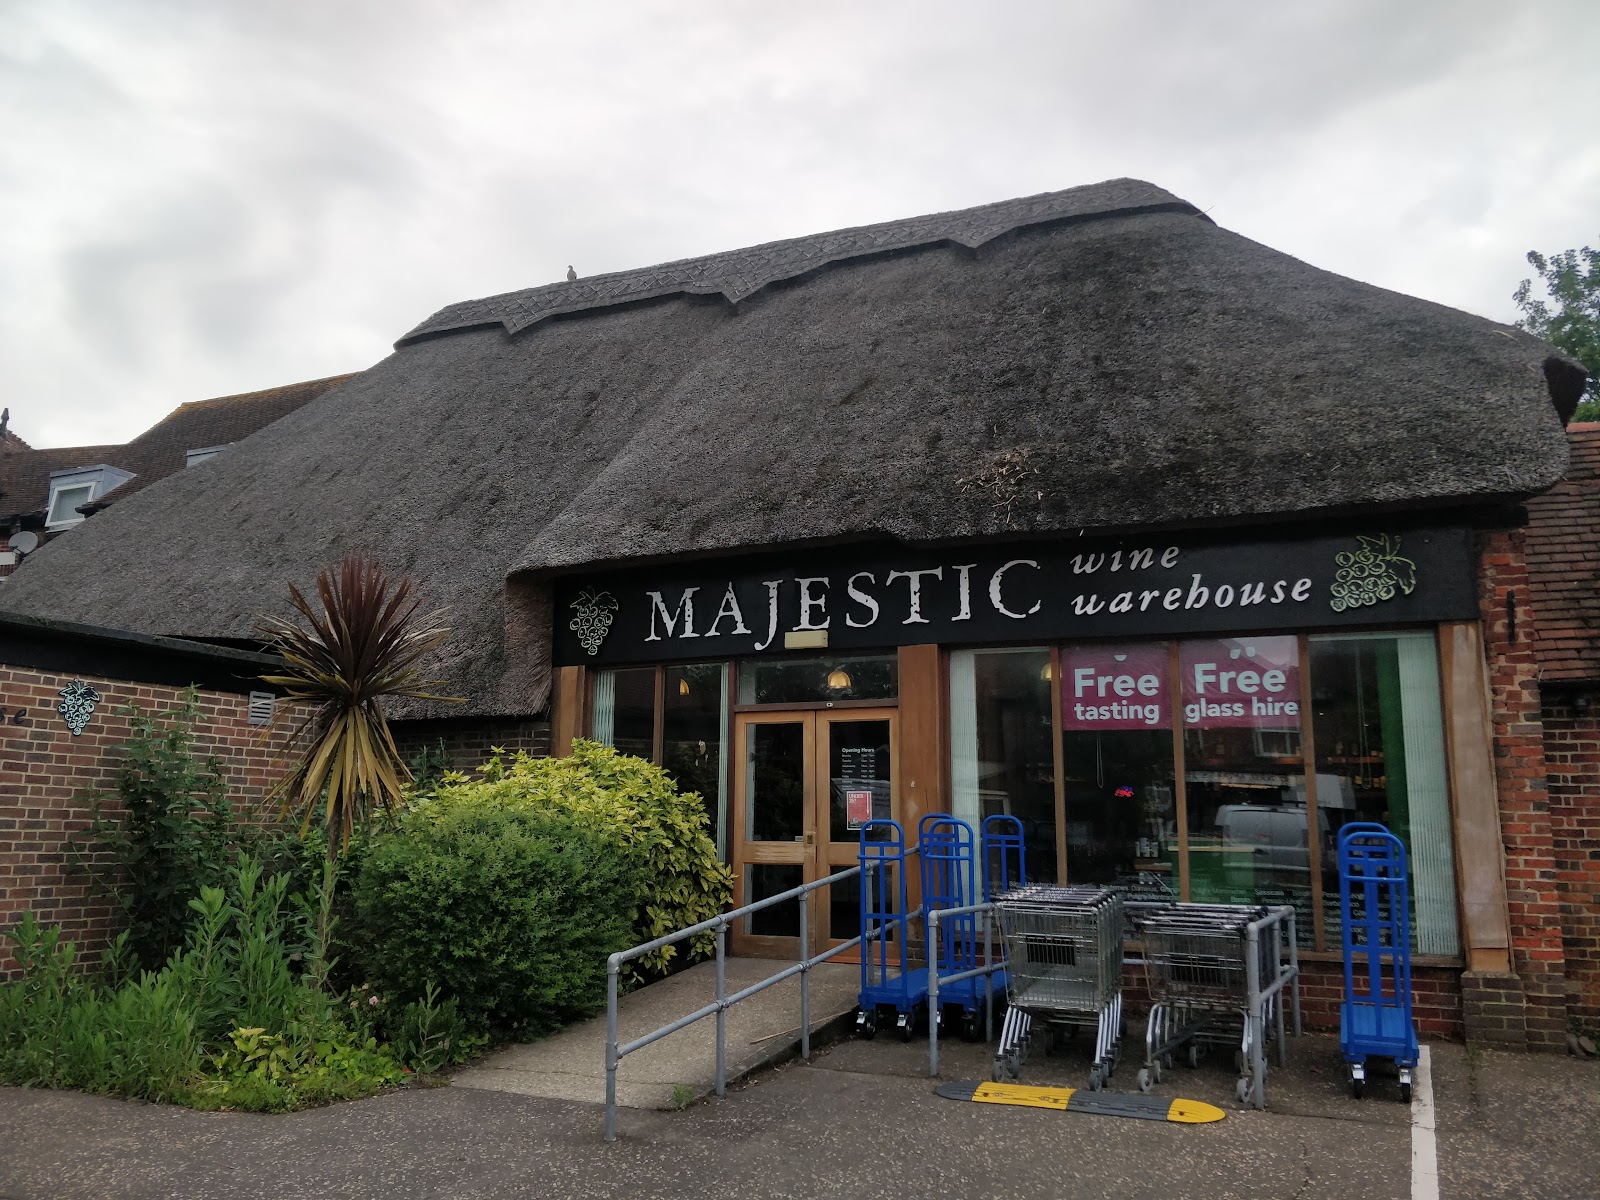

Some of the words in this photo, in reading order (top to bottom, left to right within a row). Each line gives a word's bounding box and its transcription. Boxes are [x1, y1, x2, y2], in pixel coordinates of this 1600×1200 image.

[1070, 545, 1180, 575] wine
[643, 558, 1042, 651] MAJESTIC
[1071, 573, 1313, 616] warehouse
[1073, 667, 1161, 698] Free
[1194, 662, 1288, 695] Free
[1073, 700, 1161, 725] tasting
[1185, 697, 1245, 724] glass
[1251, 697, 1299, 717] hire
